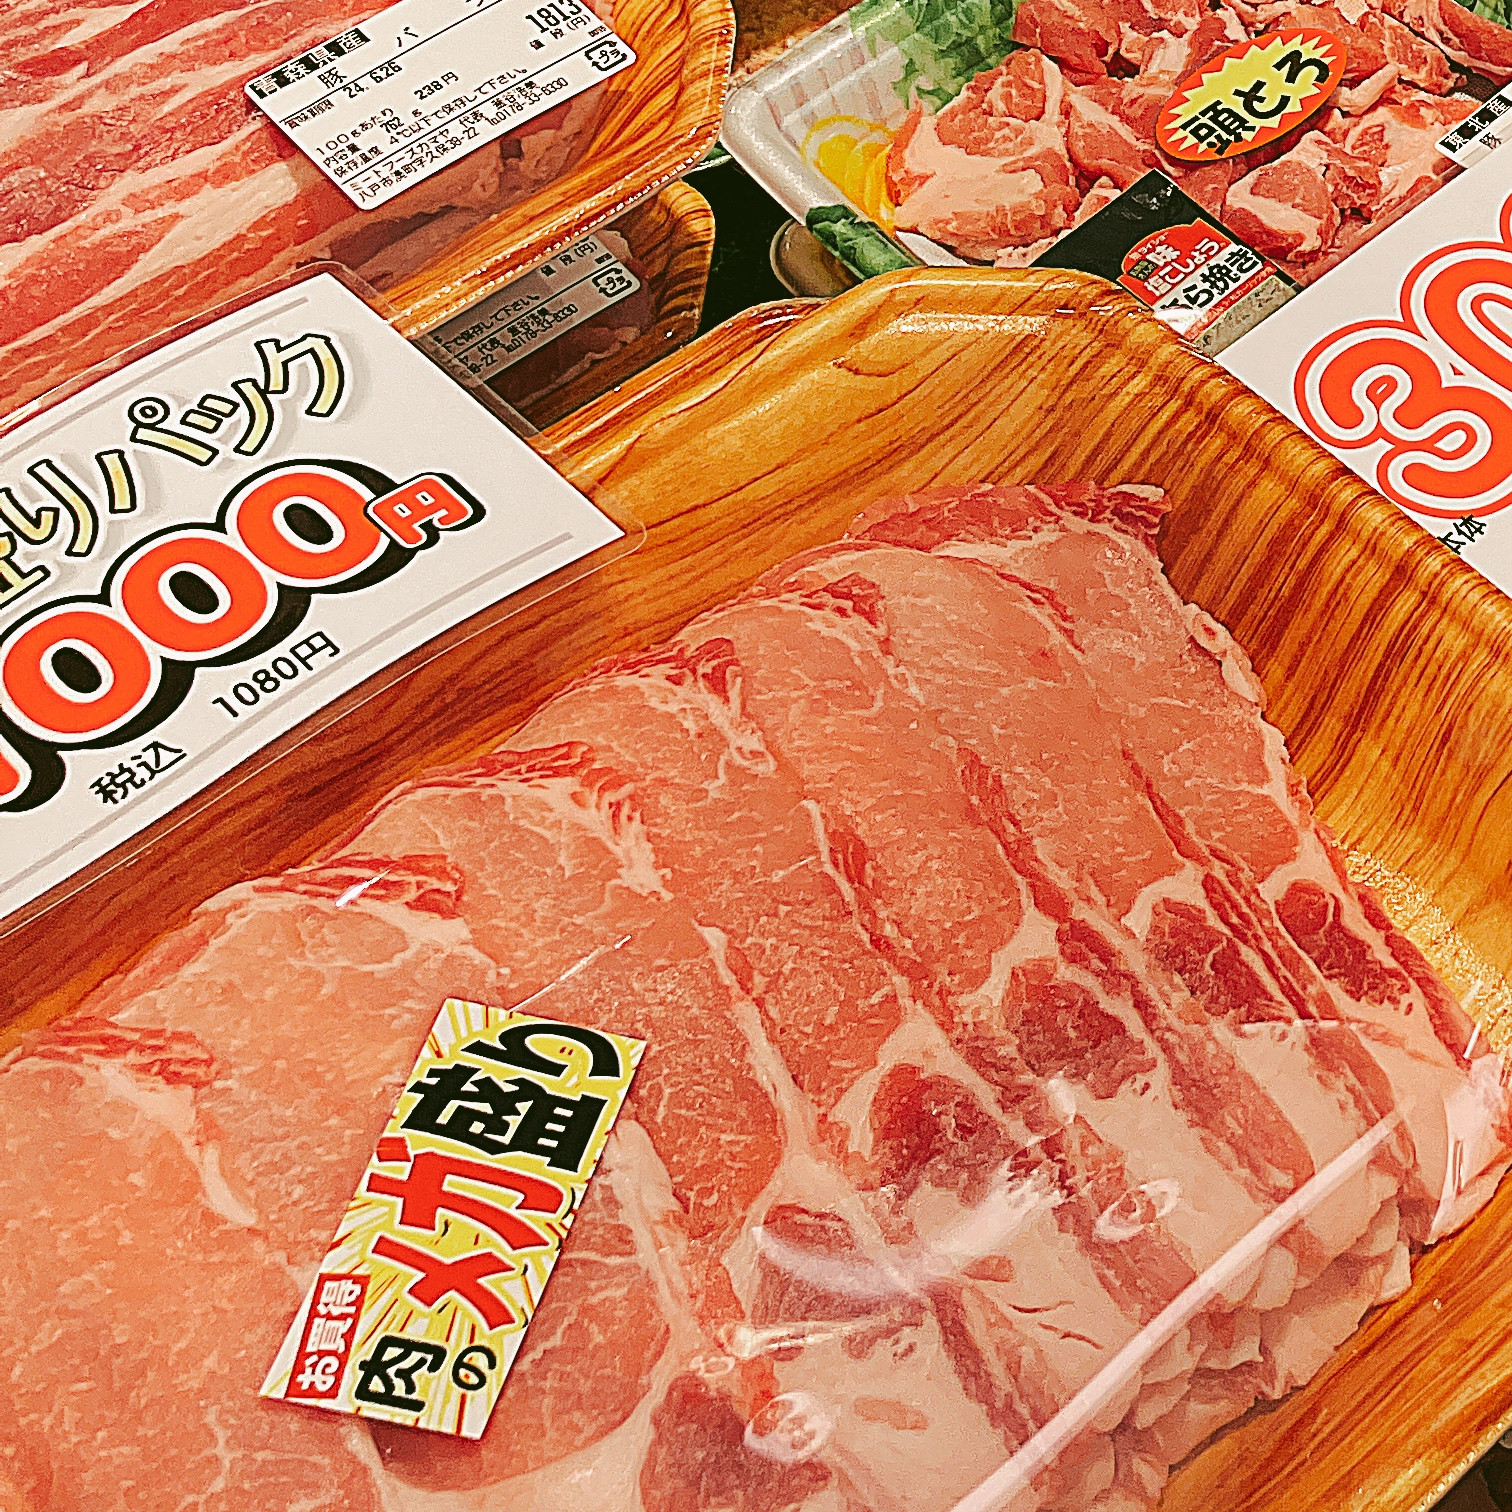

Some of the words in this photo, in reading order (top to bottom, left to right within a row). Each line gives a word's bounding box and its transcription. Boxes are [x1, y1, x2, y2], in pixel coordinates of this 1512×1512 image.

[380, 117, 404, 133] 762
[414, 72, 458, 100] 238円
[1182, 50, 1331, 156] 頭とろ
[0, 459, 486, 810] 000円
[89, 741, 187, 804] 税込
[212, 631, 341, 718] 1080円
[367, 1023, 621, 1332] メガ盛り
[295, 1277, 363, 1391] お買得
[355, 1334, 497, 1413] 肉の
